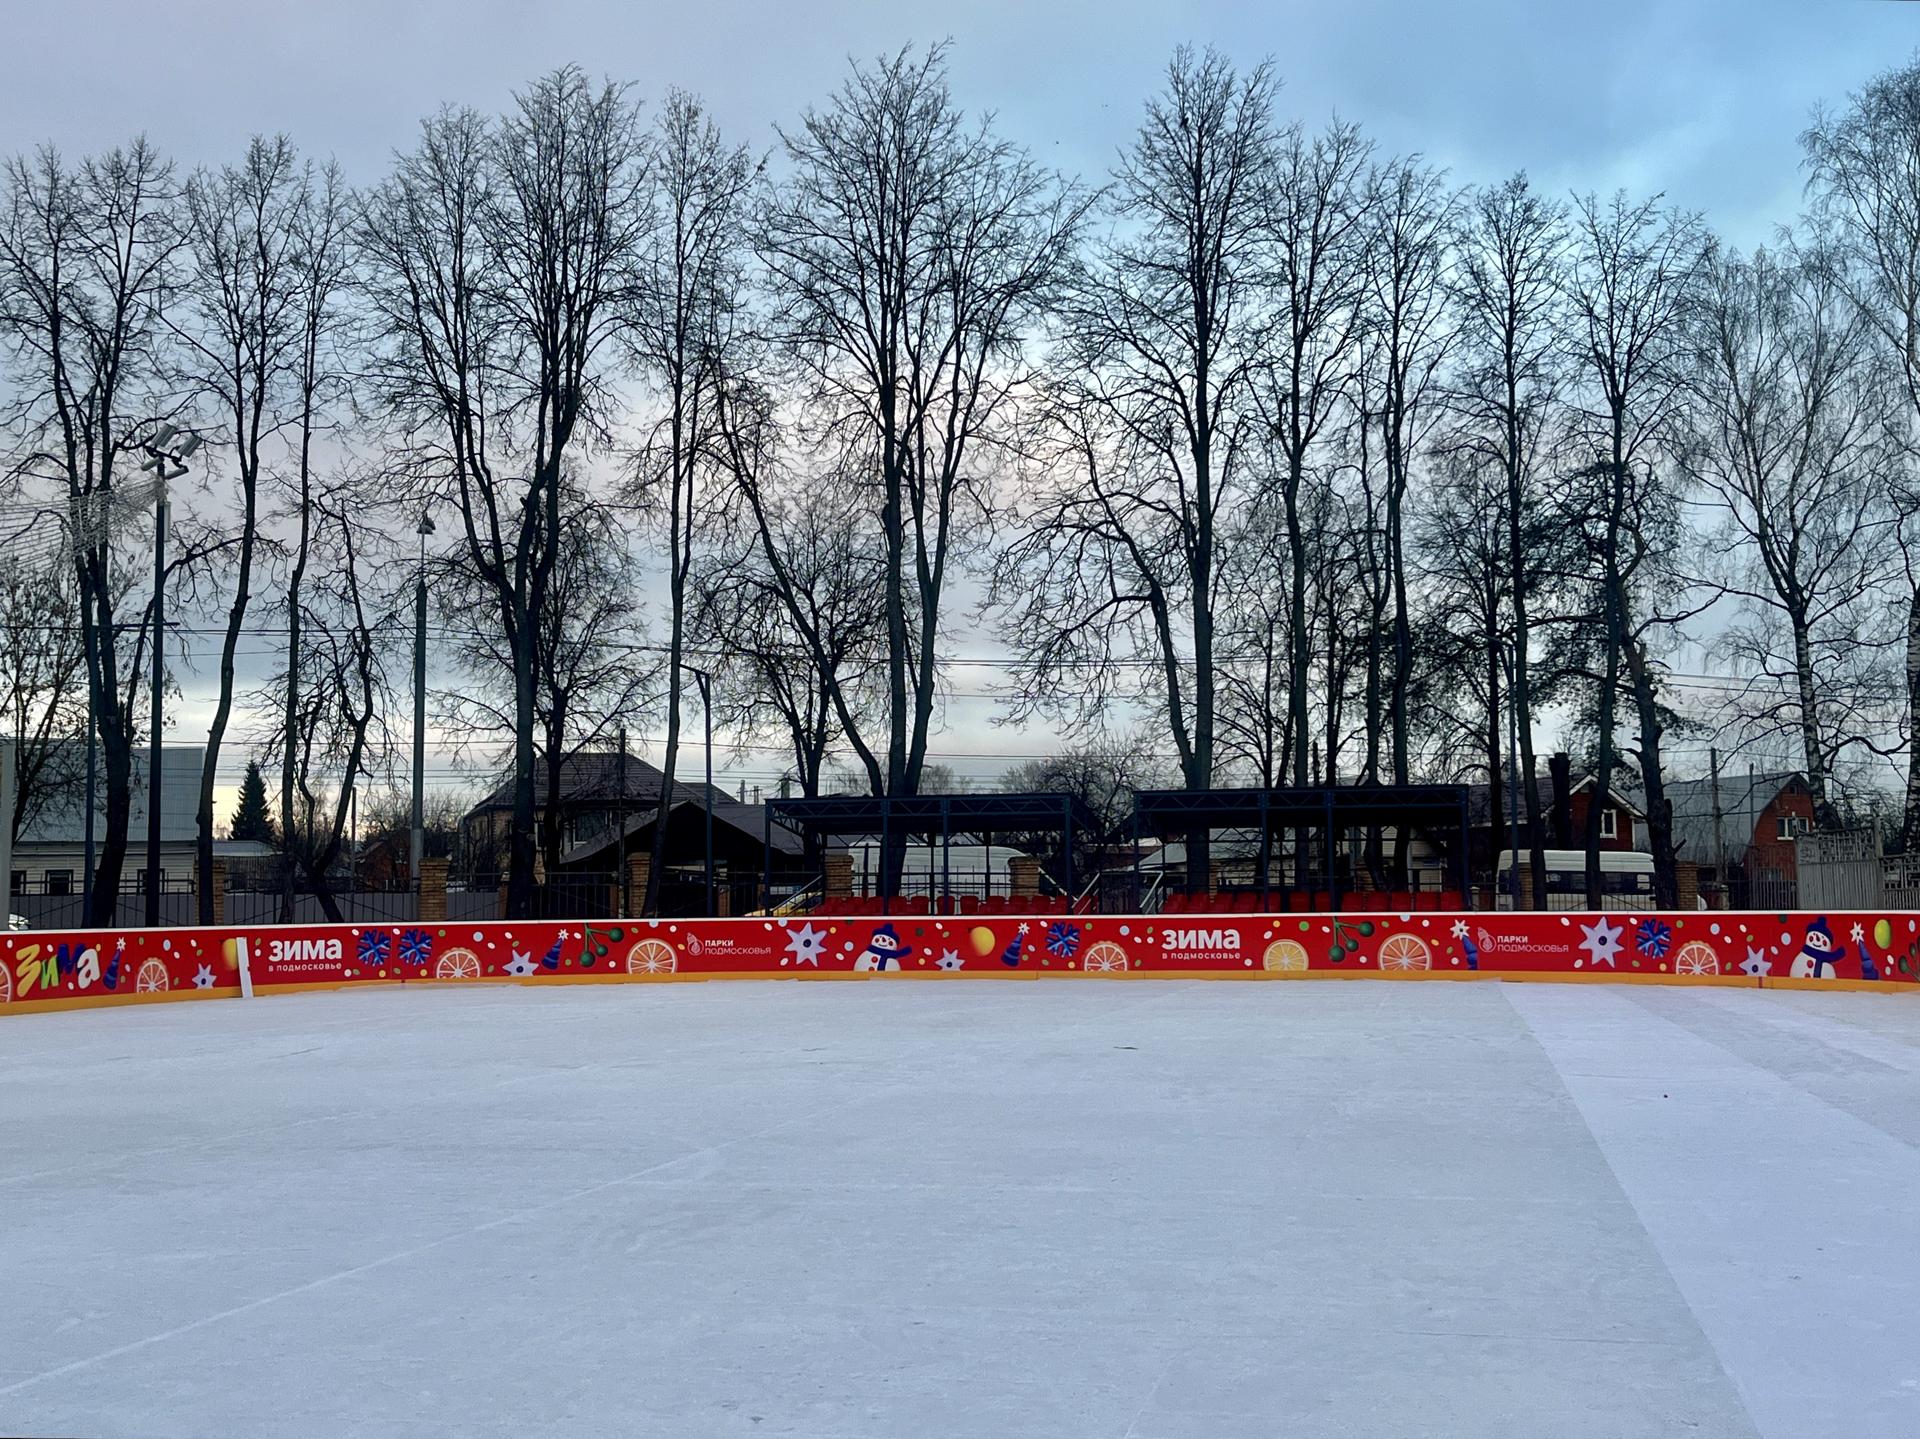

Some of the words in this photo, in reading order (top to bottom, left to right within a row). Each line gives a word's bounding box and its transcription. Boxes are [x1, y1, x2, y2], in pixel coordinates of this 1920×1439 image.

[704, 939, 734, 947] ПАРКИ
[1497, 935, 1529, 943] ПАРКИ
[704, 947, 772, 955] ПОДМОСКОВЬЯ
[1497, 944, 1569, 952] ПОДМОСКОВЬЯ
